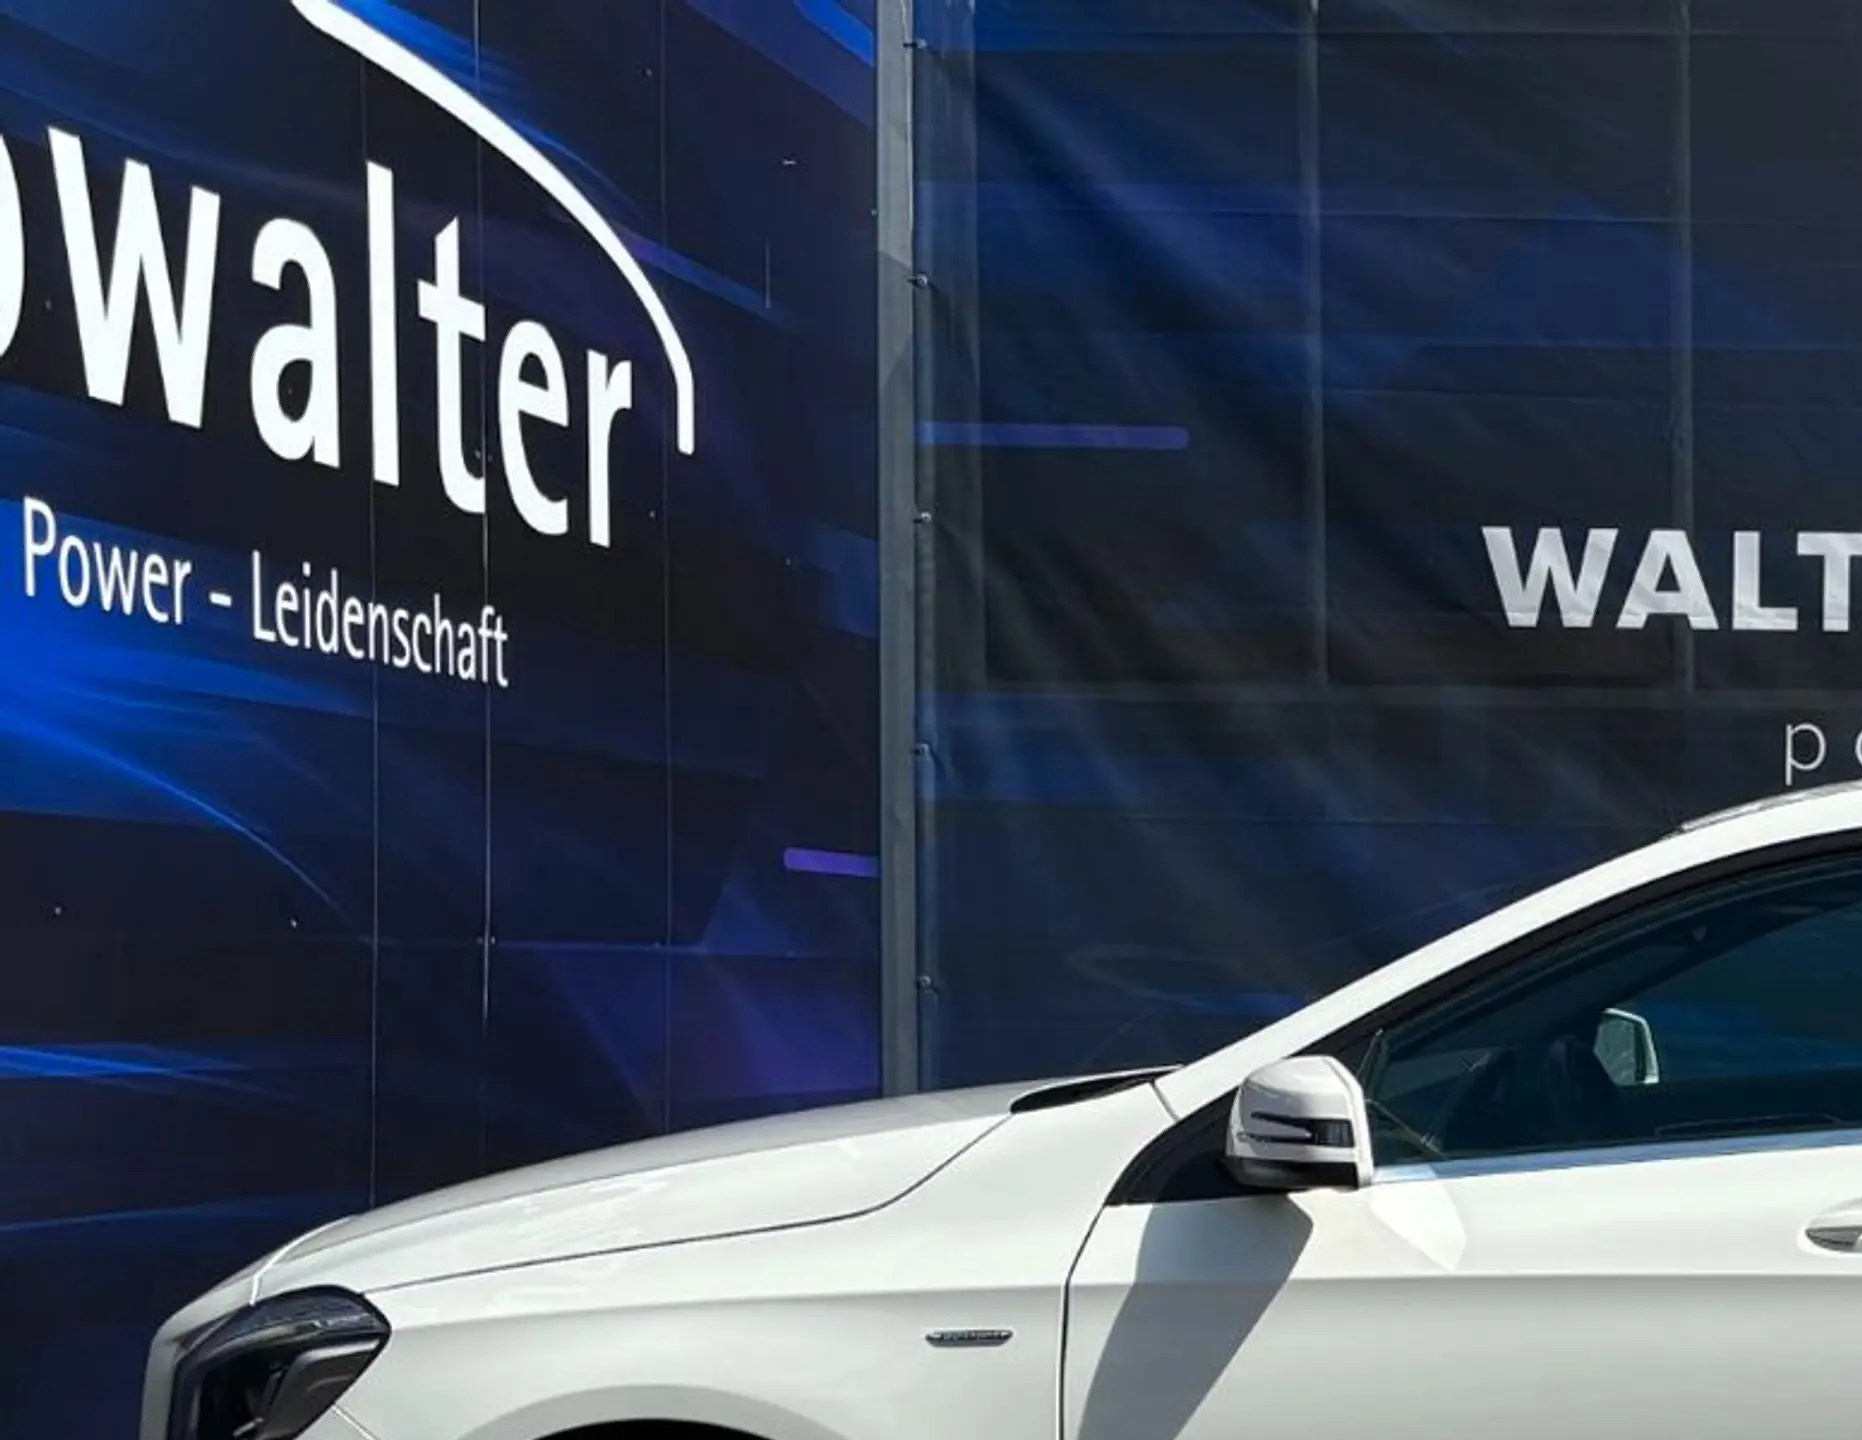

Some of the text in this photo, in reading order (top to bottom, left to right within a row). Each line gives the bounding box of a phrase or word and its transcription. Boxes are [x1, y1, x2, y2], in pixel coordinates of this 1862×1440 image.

[0, 126, 632, 548] walter
[23, 495, 192, 626] Power
[252, 549, 509, 688] Leidenschaft
